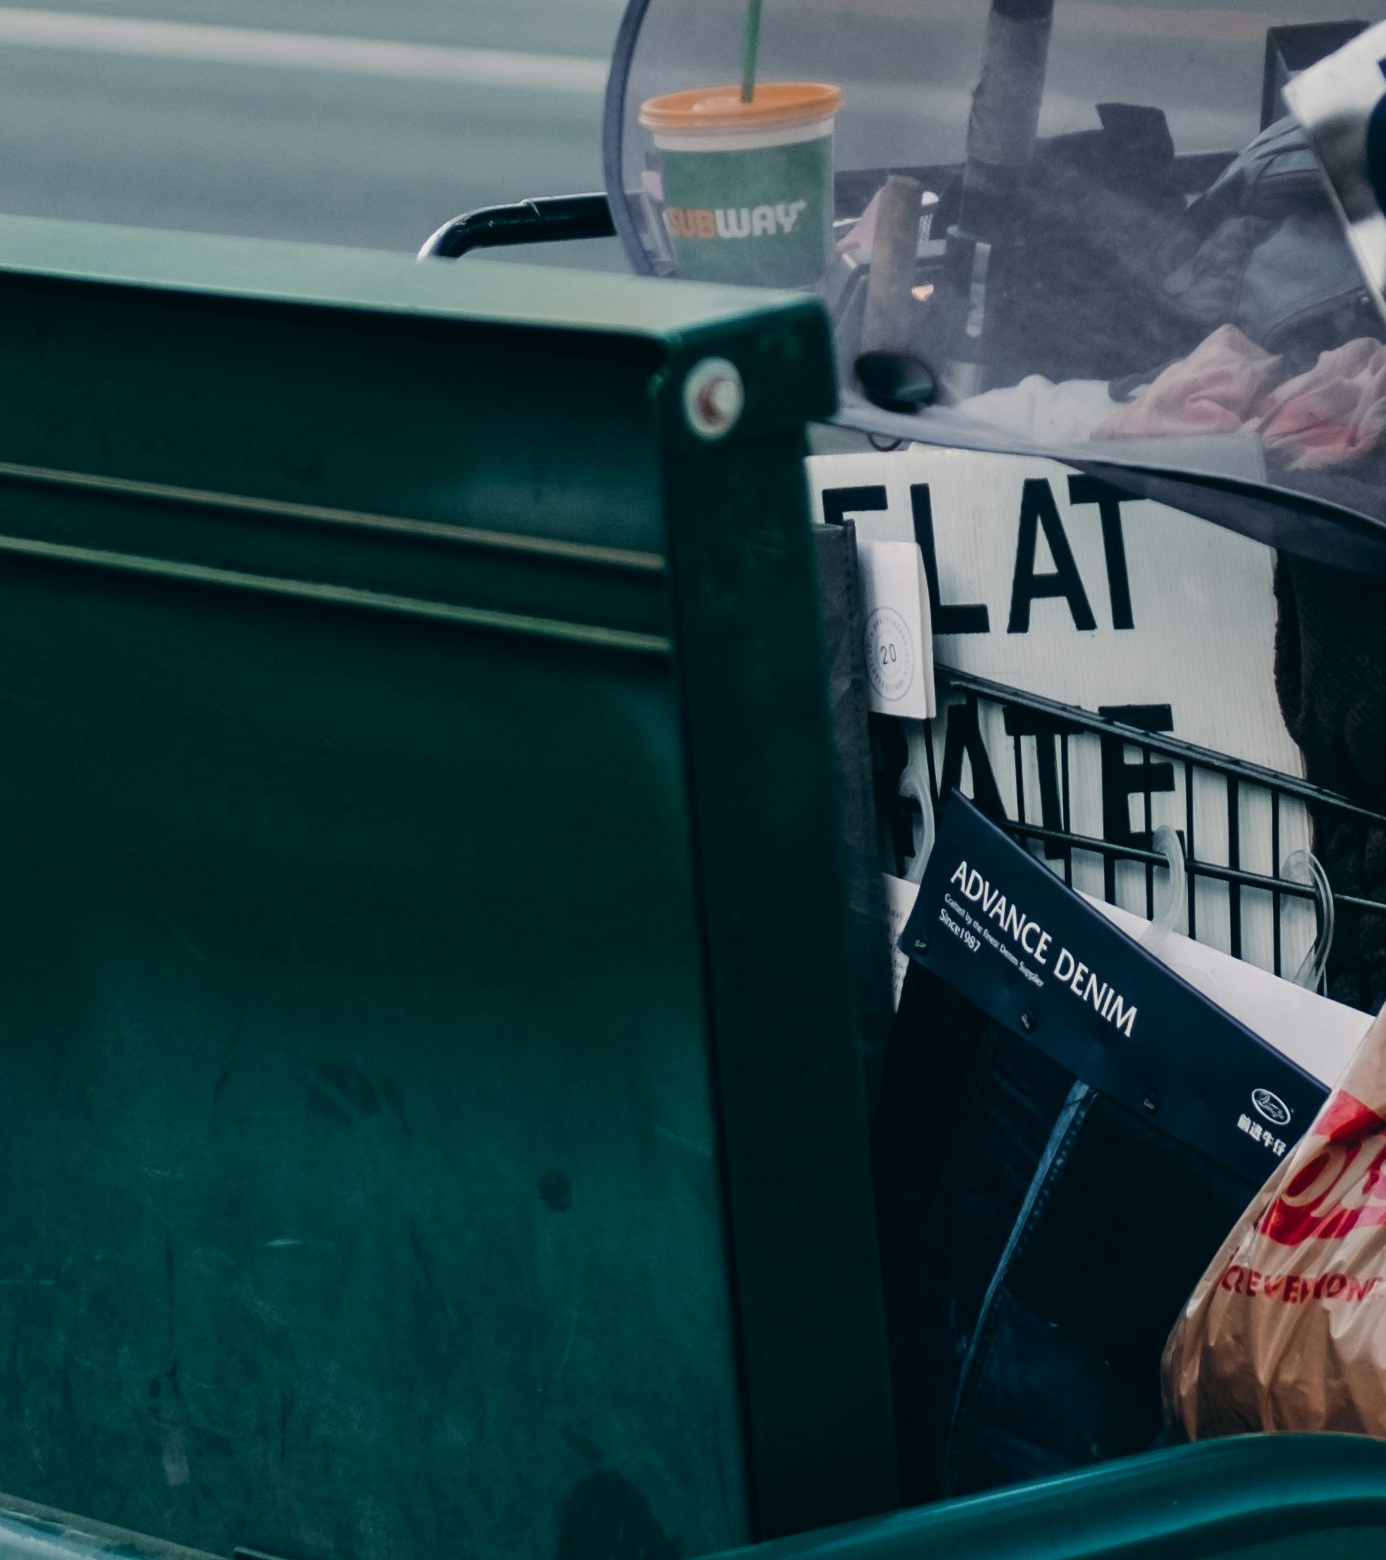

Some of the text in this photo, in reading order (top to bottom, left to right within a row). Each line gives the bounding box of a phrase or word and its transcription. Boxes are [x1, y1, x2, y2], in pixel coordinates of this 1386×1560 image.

[667, 199, 808, 241] SUBWAY
[880, 643, 897, 665] 20
[950, 860, 1139, 1038] ADVANCE DENIM
